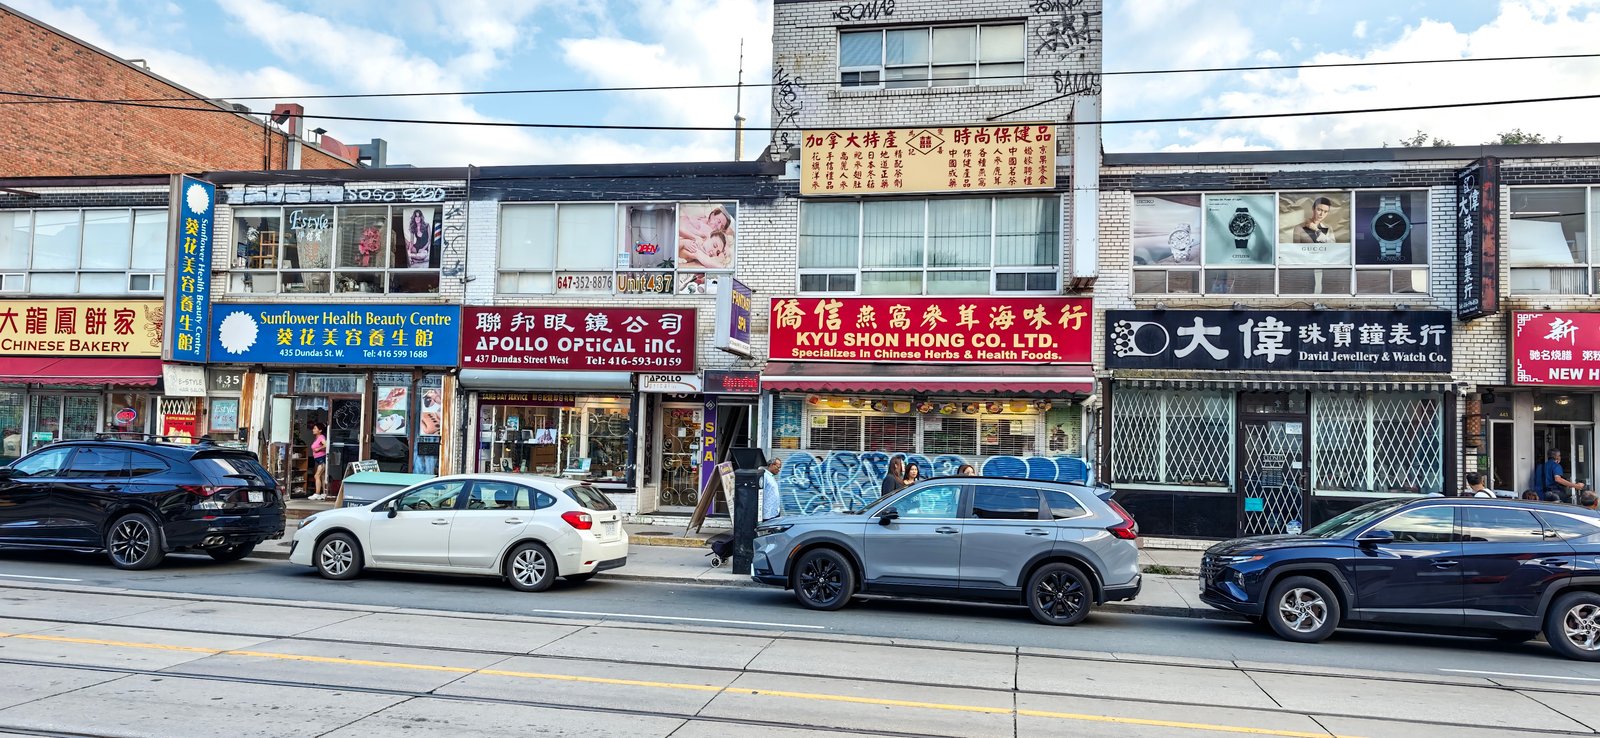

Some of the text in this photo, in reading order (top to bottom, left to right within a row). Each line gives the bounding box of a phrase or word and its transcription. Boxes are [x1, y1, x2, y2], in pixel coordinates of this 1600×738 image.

[805, 130, 898, 149] 加拿大特產
[953, 125, 1052, 146] 時尚保健品
[636, 243, 657, 254] OPEN
[177, 217, 199, 351] 葵花美容養生館
[193, 218, 209, 355] Sunflower Health Beauty Centre
[557, 275, 613, 289] 647-352-8876
[260, 311, 452, 329] Sunflower Health Beauty Centre
[475, 311, 683, 336] 聯邦眼鏡公司
[276, 328, 433, 347] 葵花美容養生館
[475, 336, 549, 351] APOLLO
[796, 332, 1058, 349] KYU SHON HONG CO. LTD.
[1173, 315, 1447, 364] 大偉 珠寶鐘表行
[279, 349, 345, 358] 435 Dundas St. W.
[363, 350, 428, 359] Tel: 416 599 1688
[475, 355, 569, 365] 437 Dundas Street West
[585, 355, 682, 366] Tel: 416-593-0159
[791, 348, 1062, 361] Specializes In Chinese Herbs & Health Foods.
[1299, 351, 1448, 365] David Jewellery & Watch Co.
[216, 375, 240, 385] 435
[1548, 367, 1584, 380] NEW
[704, 421, 715, 462] SPA
